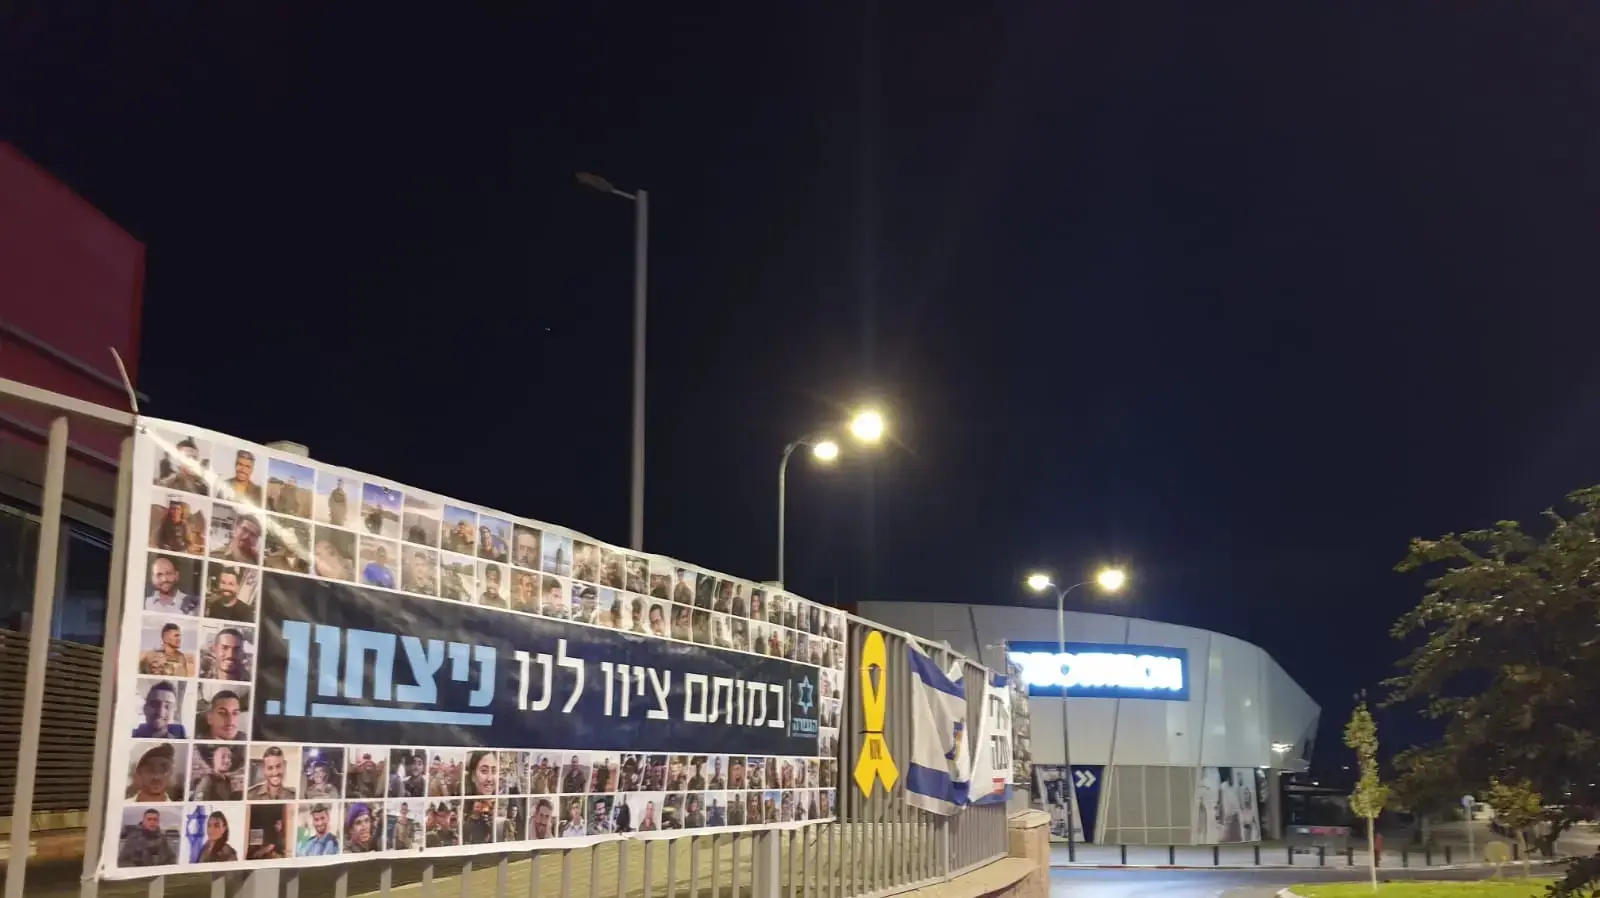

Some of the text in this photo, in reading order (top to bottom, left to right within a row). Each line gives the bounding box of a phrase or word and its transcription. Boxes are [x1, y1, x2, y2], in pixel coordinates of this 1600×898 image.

[265, 620, 785, 728] במותם ציוו לנו ניצחון.
